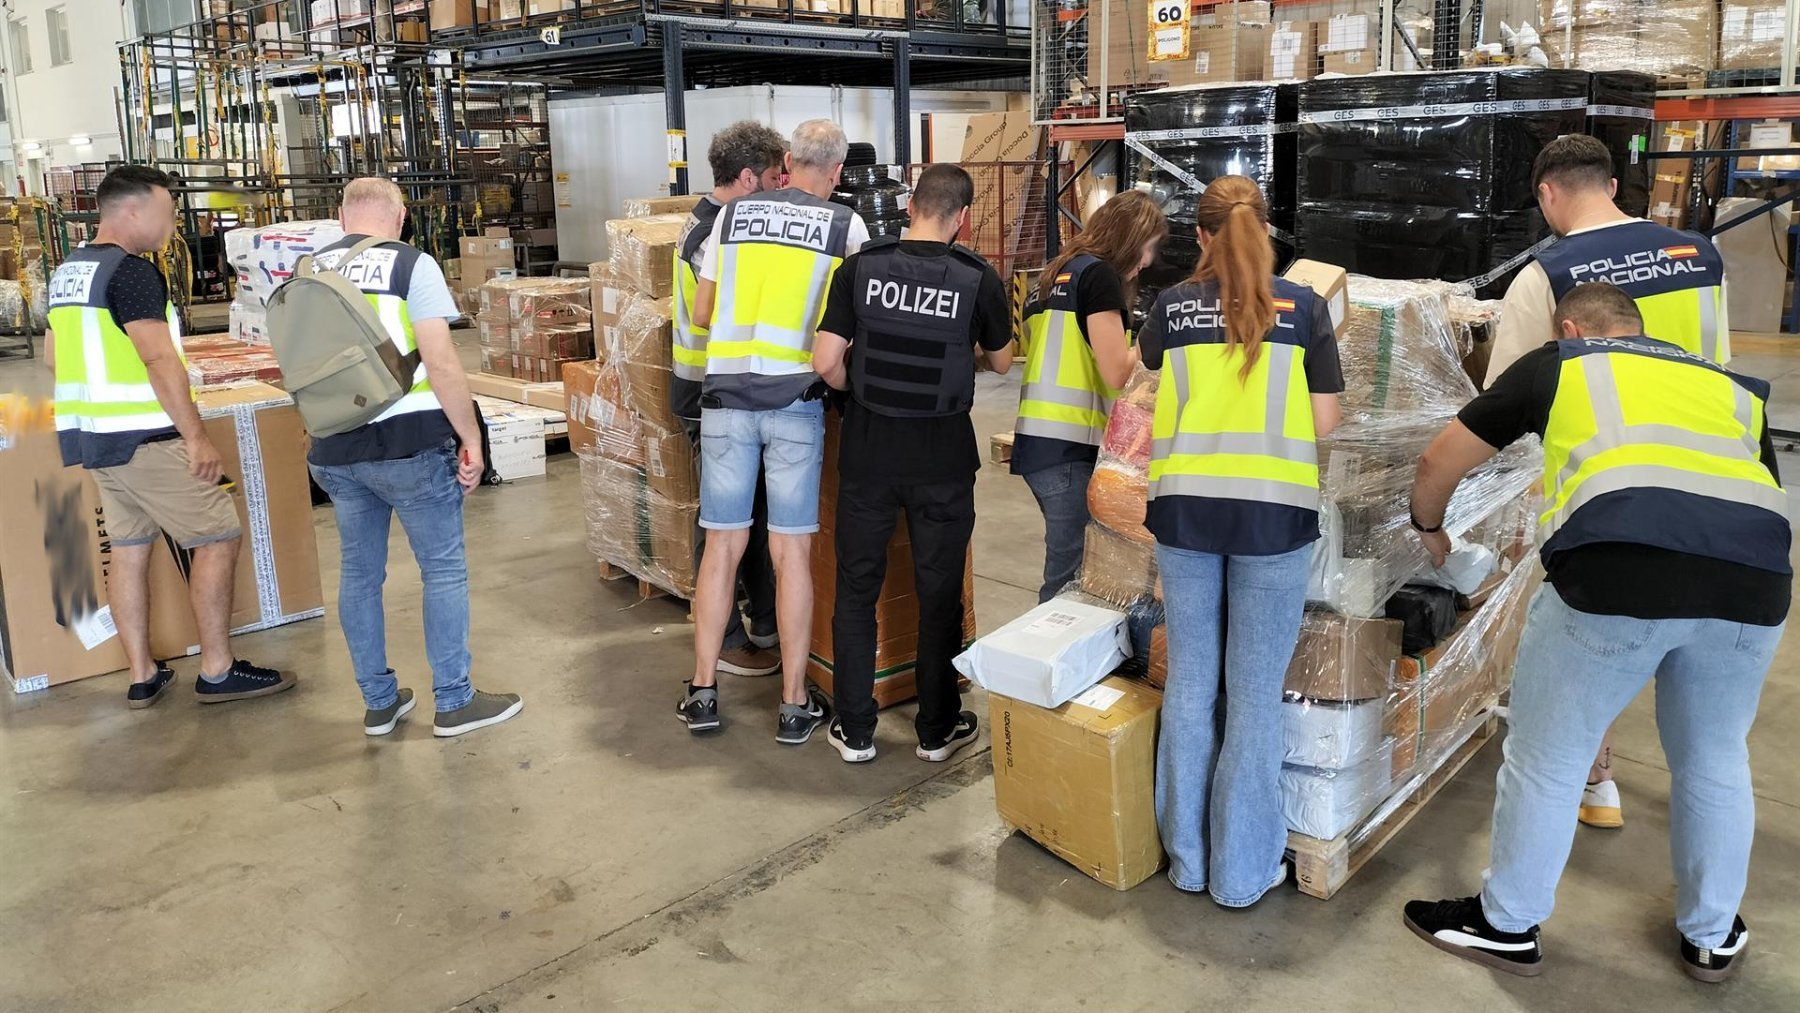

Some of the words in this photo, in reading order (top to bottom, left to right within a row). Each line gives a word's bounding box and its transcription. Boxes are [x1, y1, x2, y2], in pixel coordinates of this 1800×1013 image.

[1158, 6, 1182, 22] 60
[546, 30, 556, 42] 61
[1423, 106, 1446, 115] GES
[1473, 102, 1497, 112] GES
[1513, 101, 1526, 110] GES
[1334, 111, 1354, 120] GES
[1377, 108, 1399, 118] GES
[1168, 130, 1184, 138] GES
[1202, 128, 1220, 136] GES
[1239, 126, 1258, 134] GES
[962, 141, 985, 164] occia
[736, 204, 768, 216] CUERPO
[774, 206, 814, 220] NACIONAL
[816, 212, 830, 222] DE
[732, 218, 824, 246] POLICIA
[866, 278, 960, 318] POLIZEI
[1168, 313, 1294, 334] NACIL
